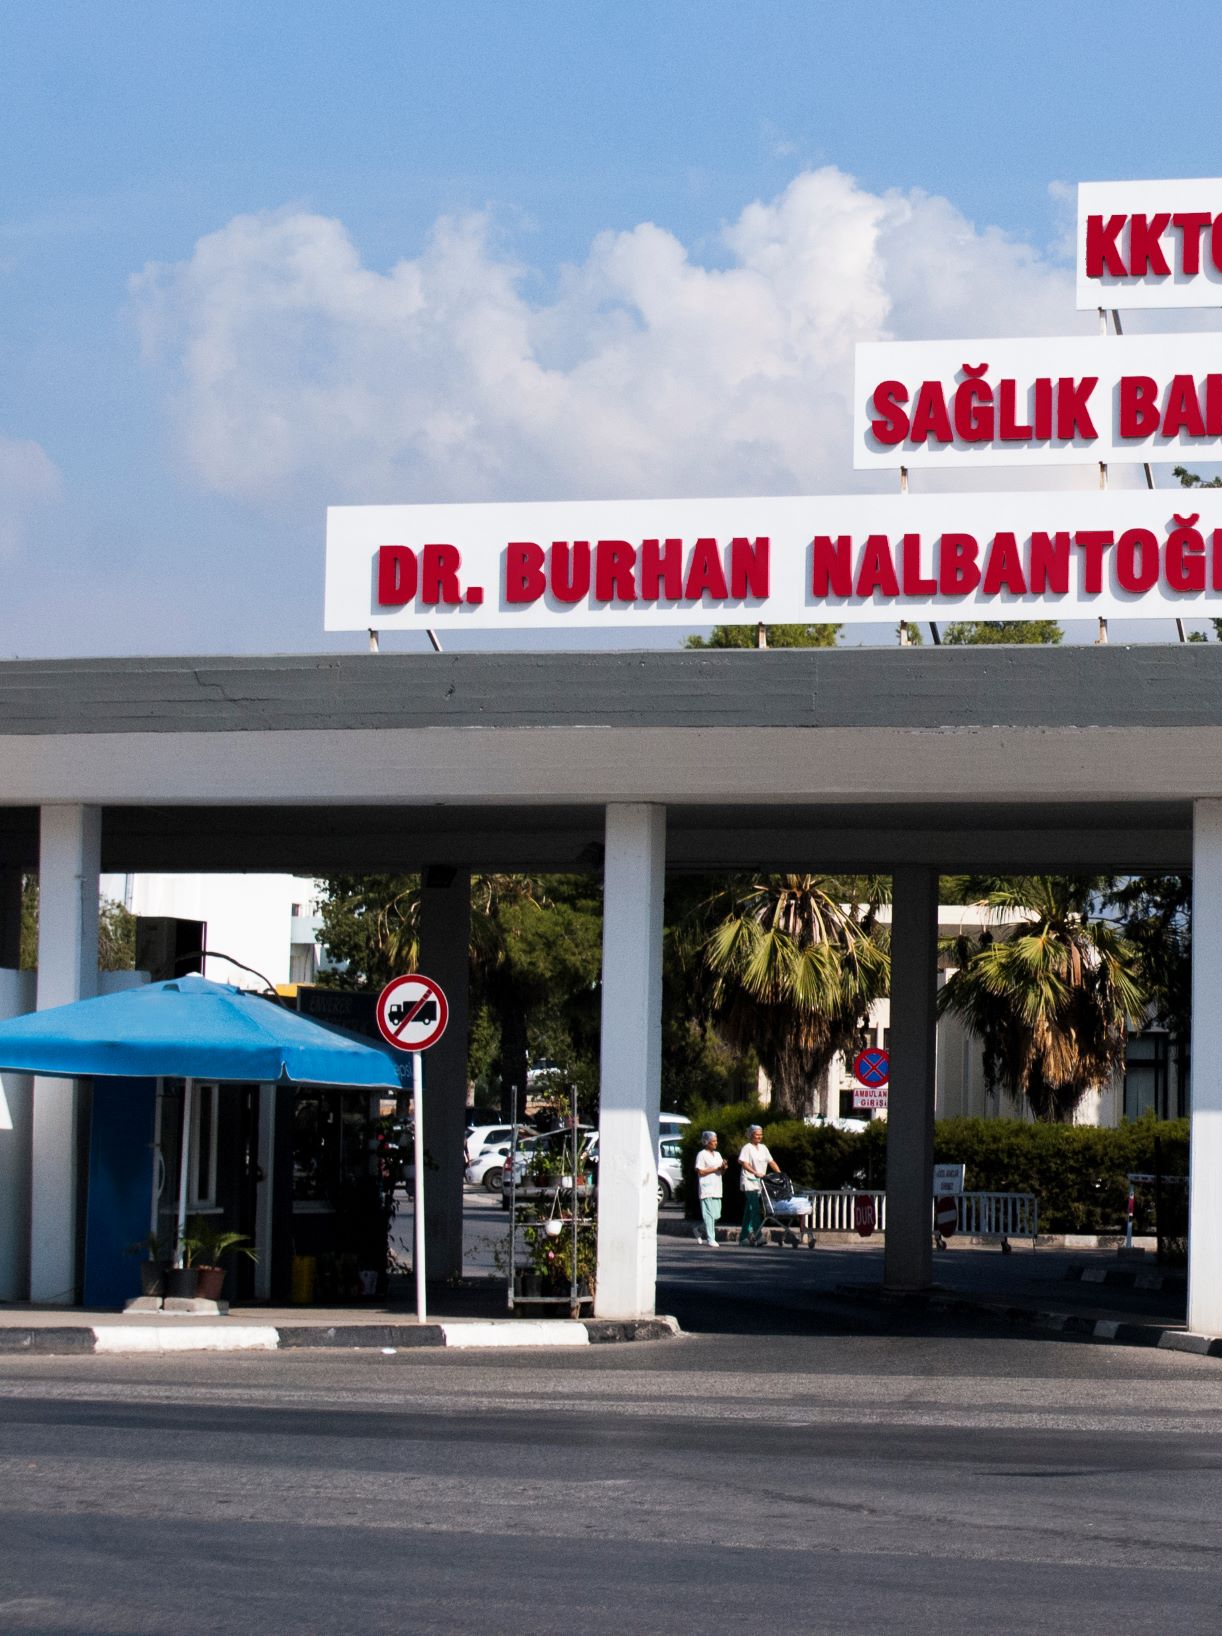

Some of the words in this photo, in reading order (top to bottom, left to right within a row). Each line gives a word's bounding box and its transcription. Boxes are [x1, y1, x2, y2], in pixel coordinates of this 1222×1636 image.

[871, 363, 1099, 445] SAĞLIK
[377, 543, 484, 606] DR.
[505, 536, 770, 604] BURHAN
[855, 1090, 888, 1098] AMBULAN
[856, 1206, 874, 1226] DUR
